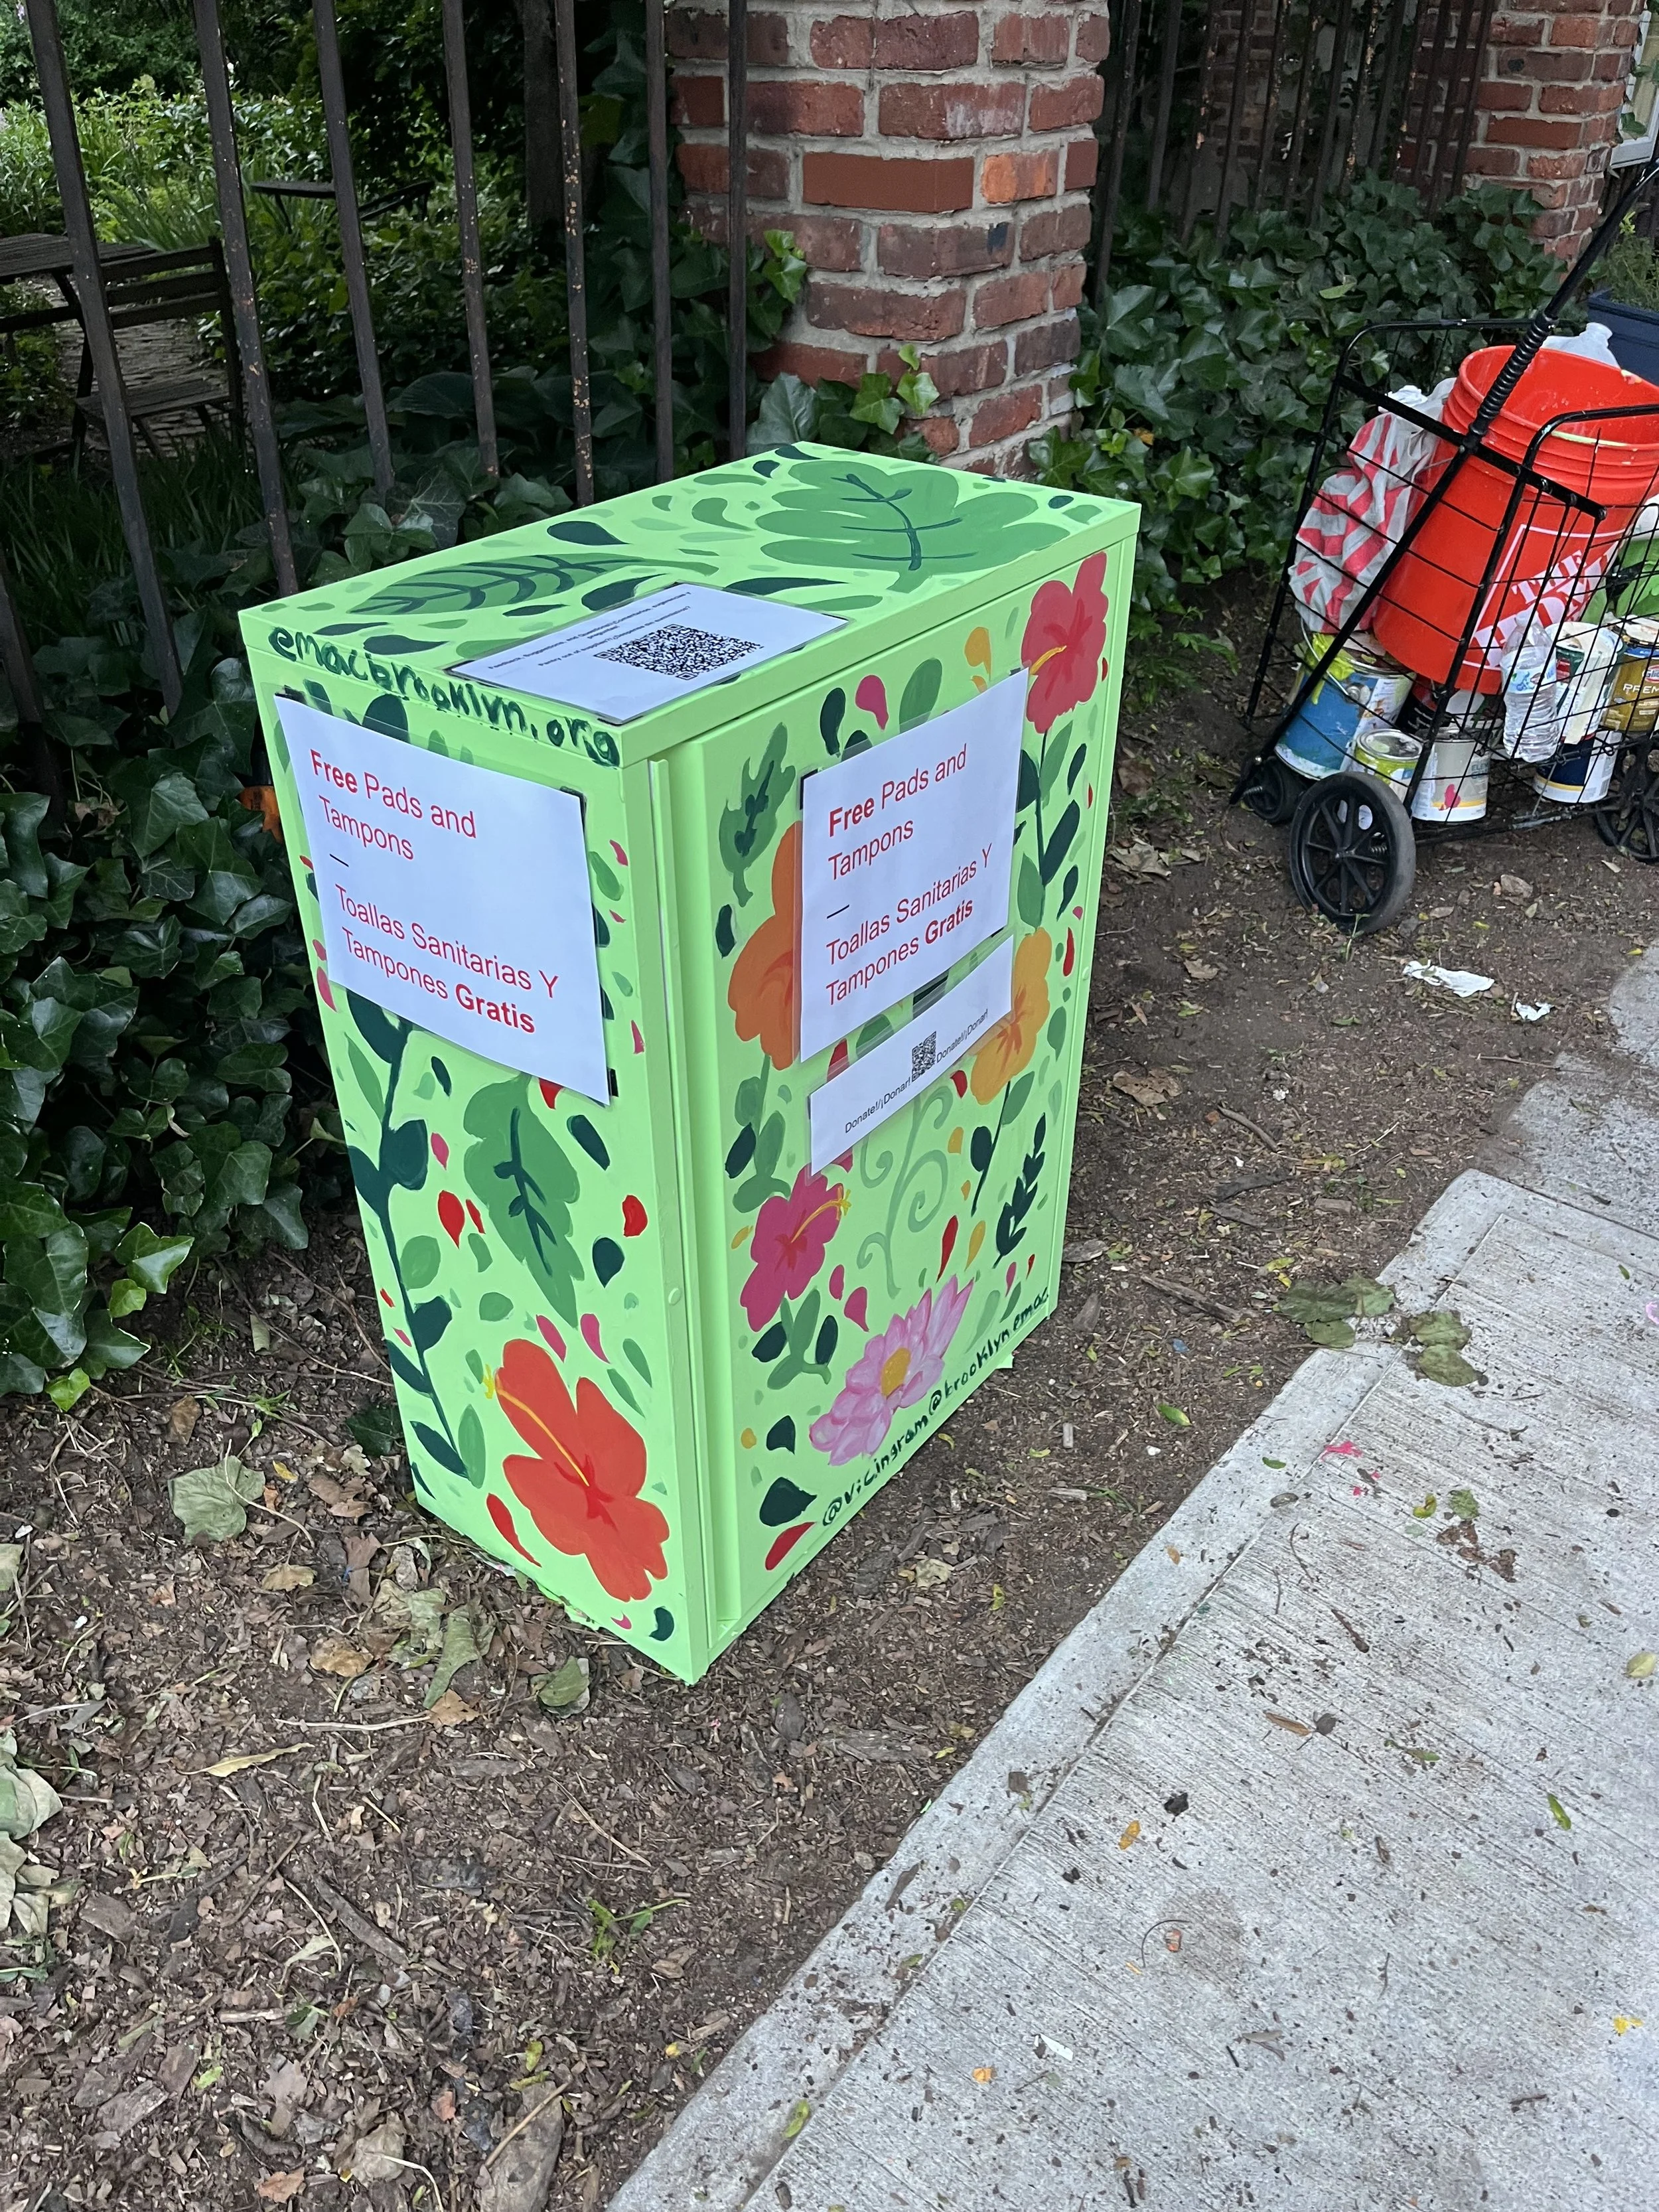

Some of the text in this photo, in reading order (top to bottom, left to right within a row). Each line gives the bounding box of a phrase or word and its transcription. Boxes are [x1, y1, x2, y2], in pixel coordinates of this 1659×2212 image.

[311, 749, 476, 838] Free Pads and
[319, 795, 413, 859] Tampons
[830, 743, 966, 837] Free Pads and
[828, 821, 913, 880] Tampons
[335, 884, 558, 997] Toallas Sanitarias Y
[826, 843, 991, 964] Toallas Sanitarias Y
[826, 900, 972, 1005] Tampones Gratis
[342, 926, 534, 1033] Tampones Gratis
